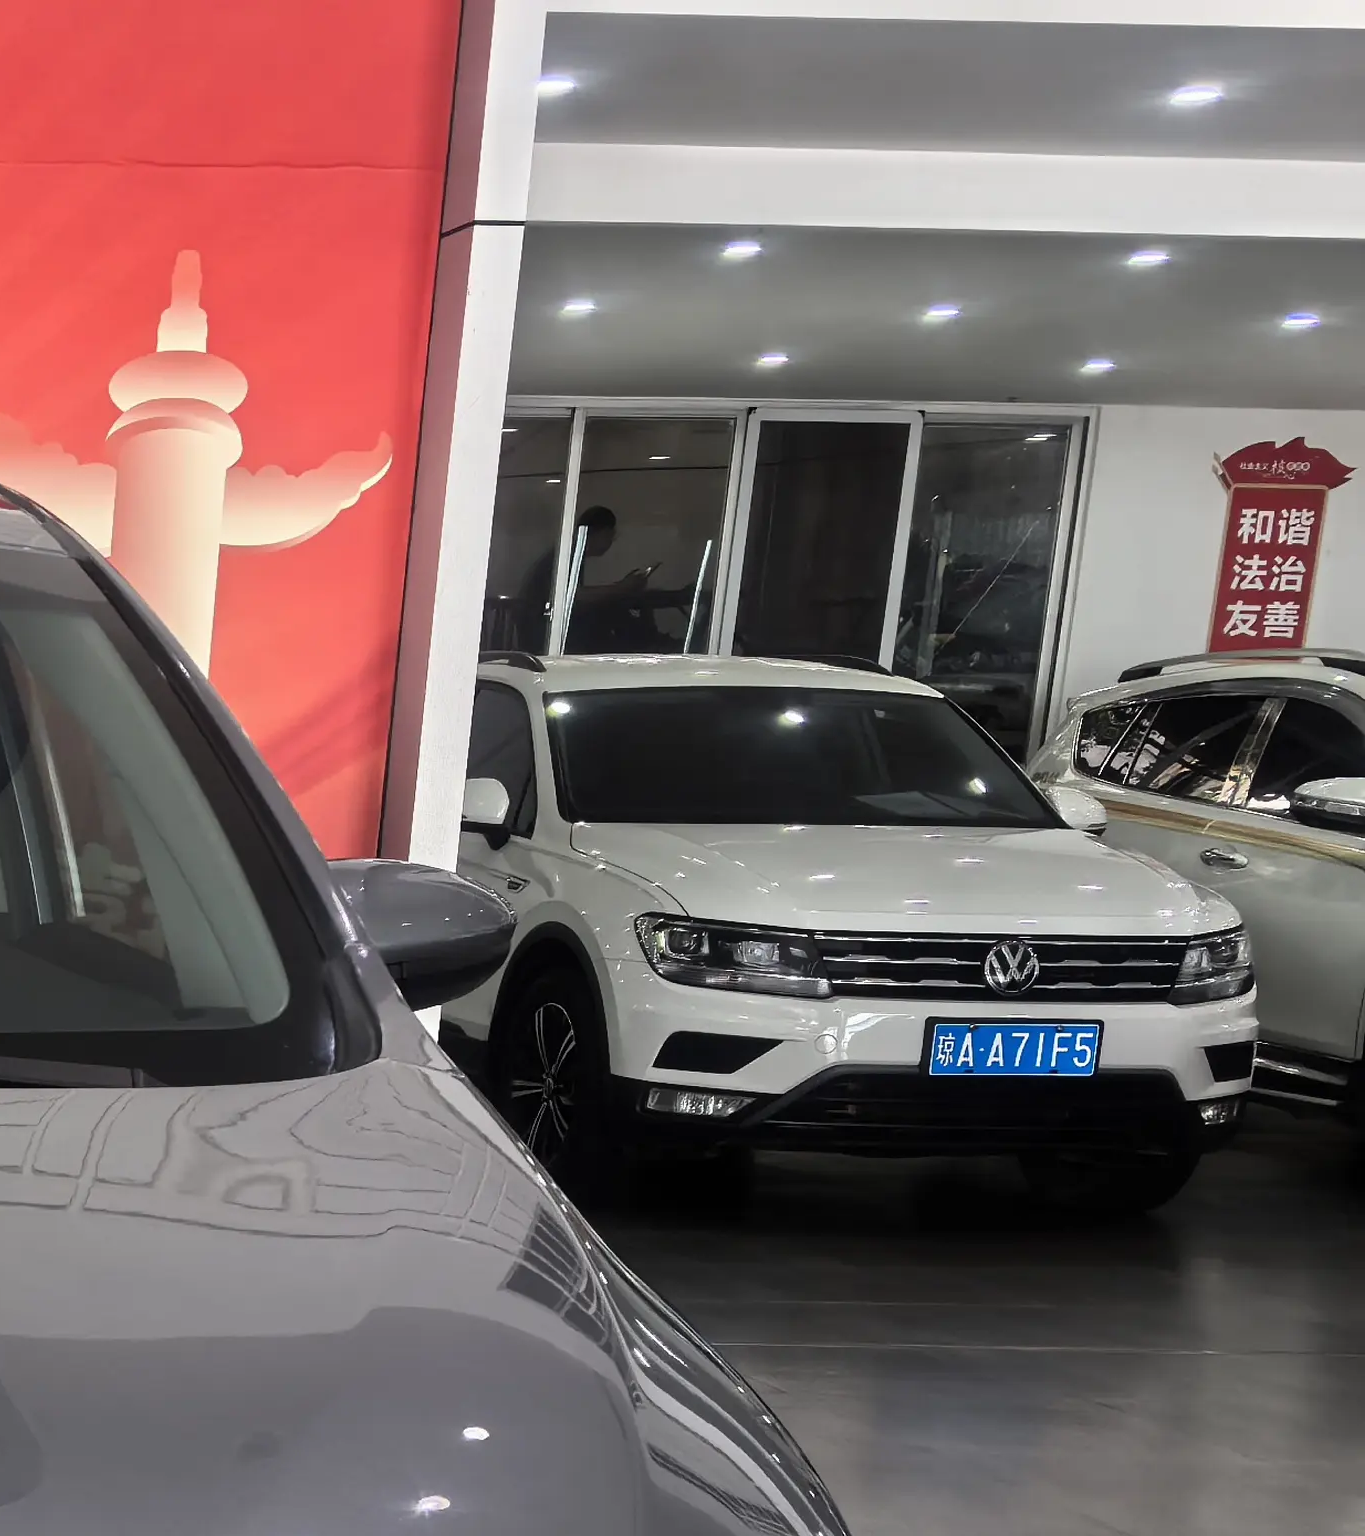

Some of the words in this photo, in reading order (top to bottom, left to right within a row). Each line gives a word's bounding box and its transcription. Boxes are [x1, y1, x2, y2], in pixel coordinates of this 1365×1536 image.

[1237, 508, 1315, 545] 和谐
[1230, 554, 1306, 592] 法治
[1223, 600, 1300, 638] 友善
